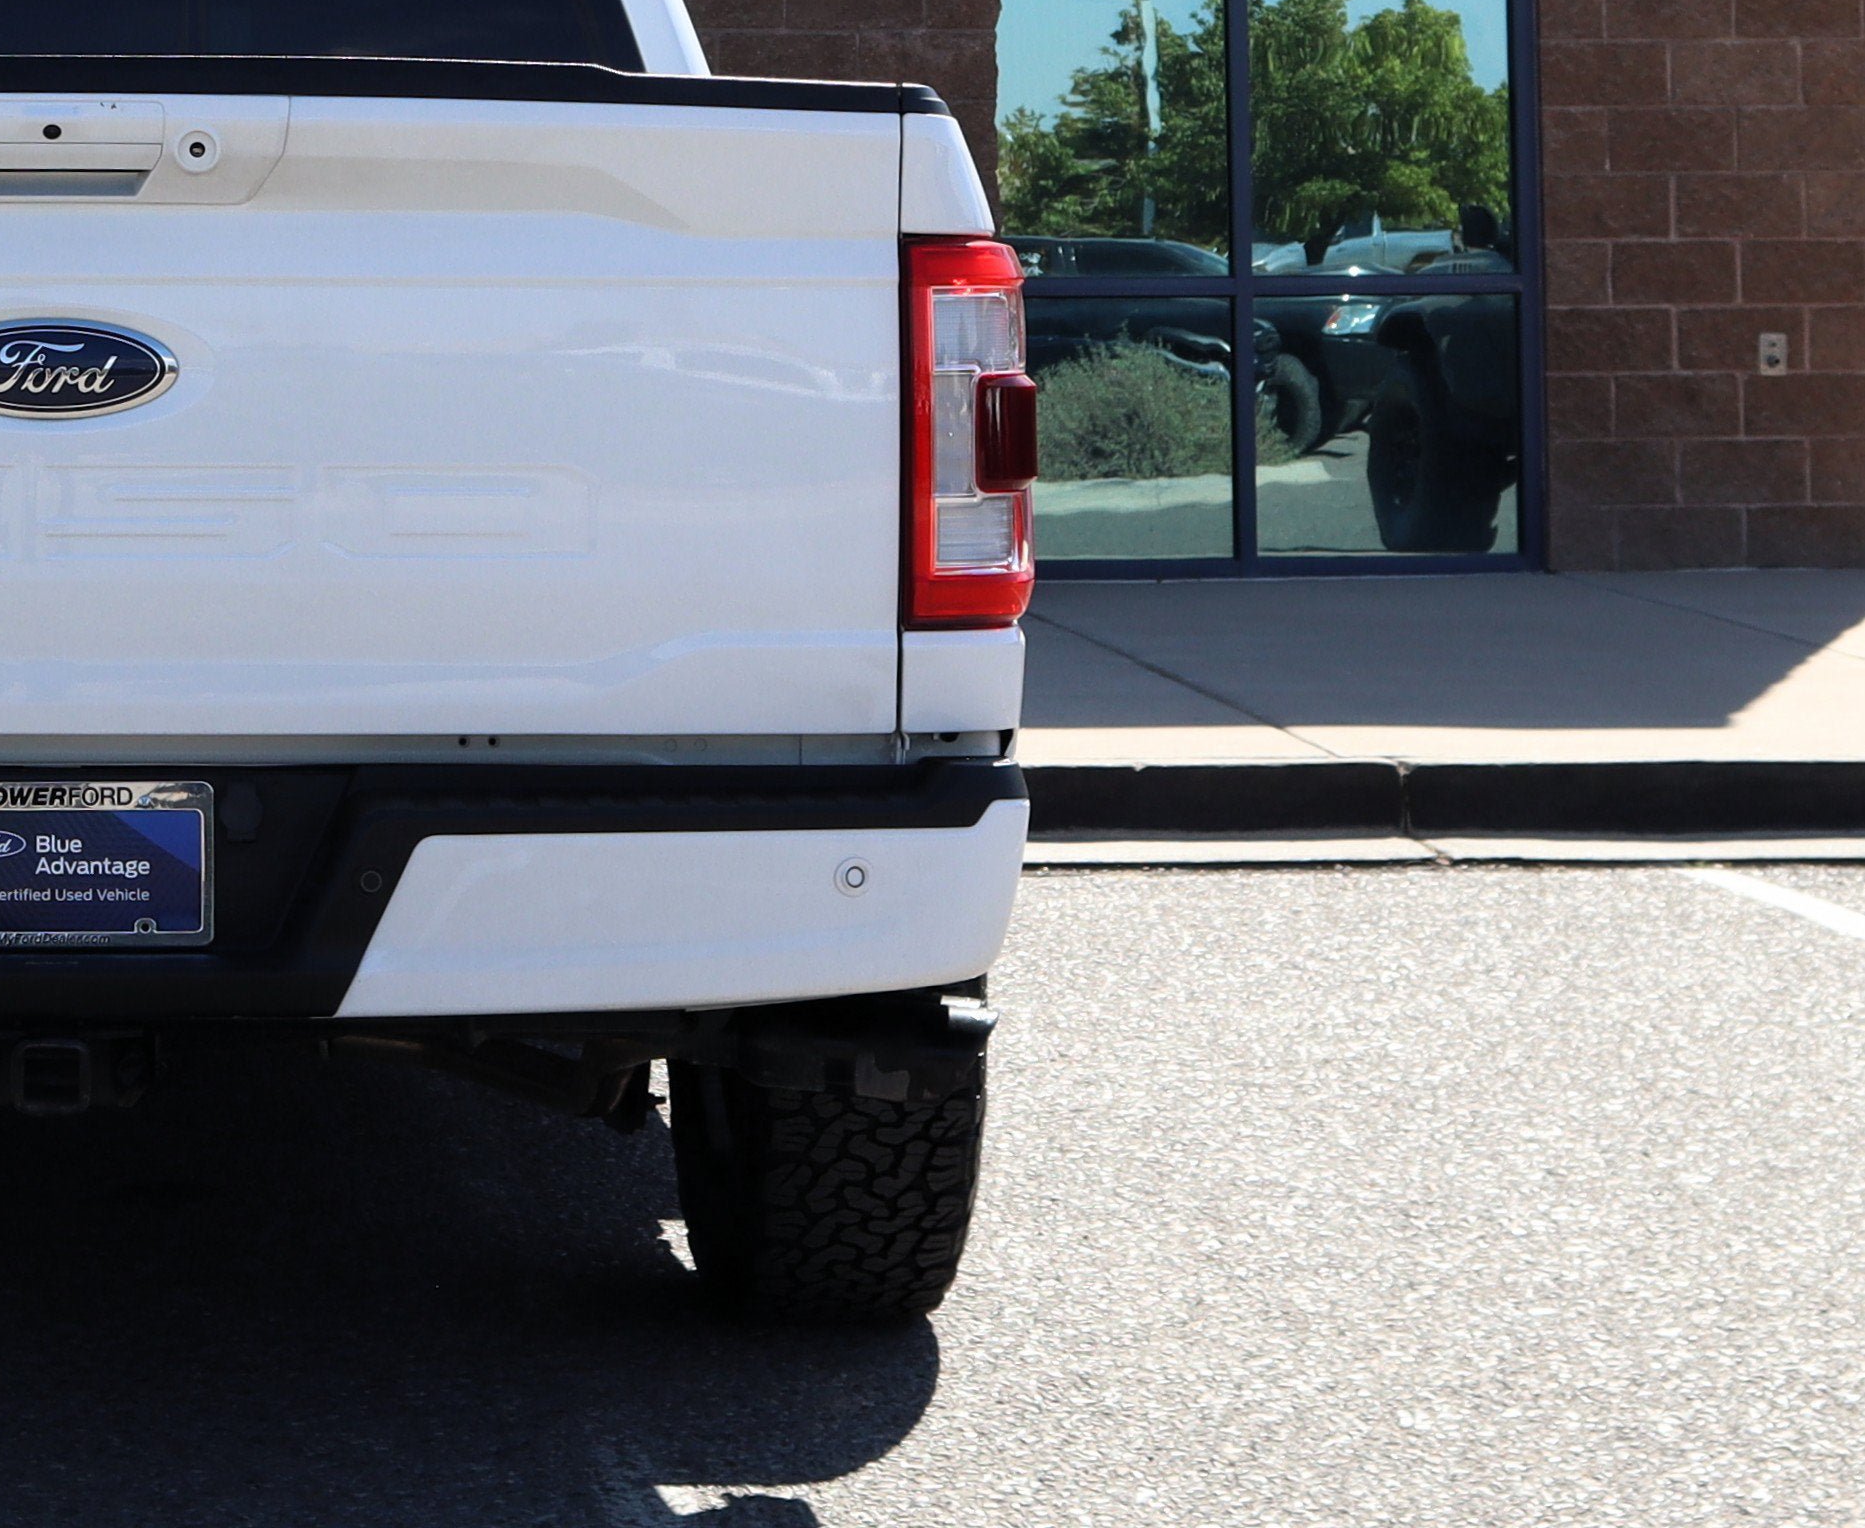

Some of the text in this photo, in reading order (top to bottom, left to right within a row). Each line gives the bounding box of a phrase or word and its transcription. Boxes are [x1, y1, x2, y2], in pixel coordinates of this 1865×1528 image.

[36, 835, 82, 853] Blue
[36, 858, 150, 878] Advantage
[55, 888, 93, 902] Used
[97, 888, 150, 902] Vehicle
